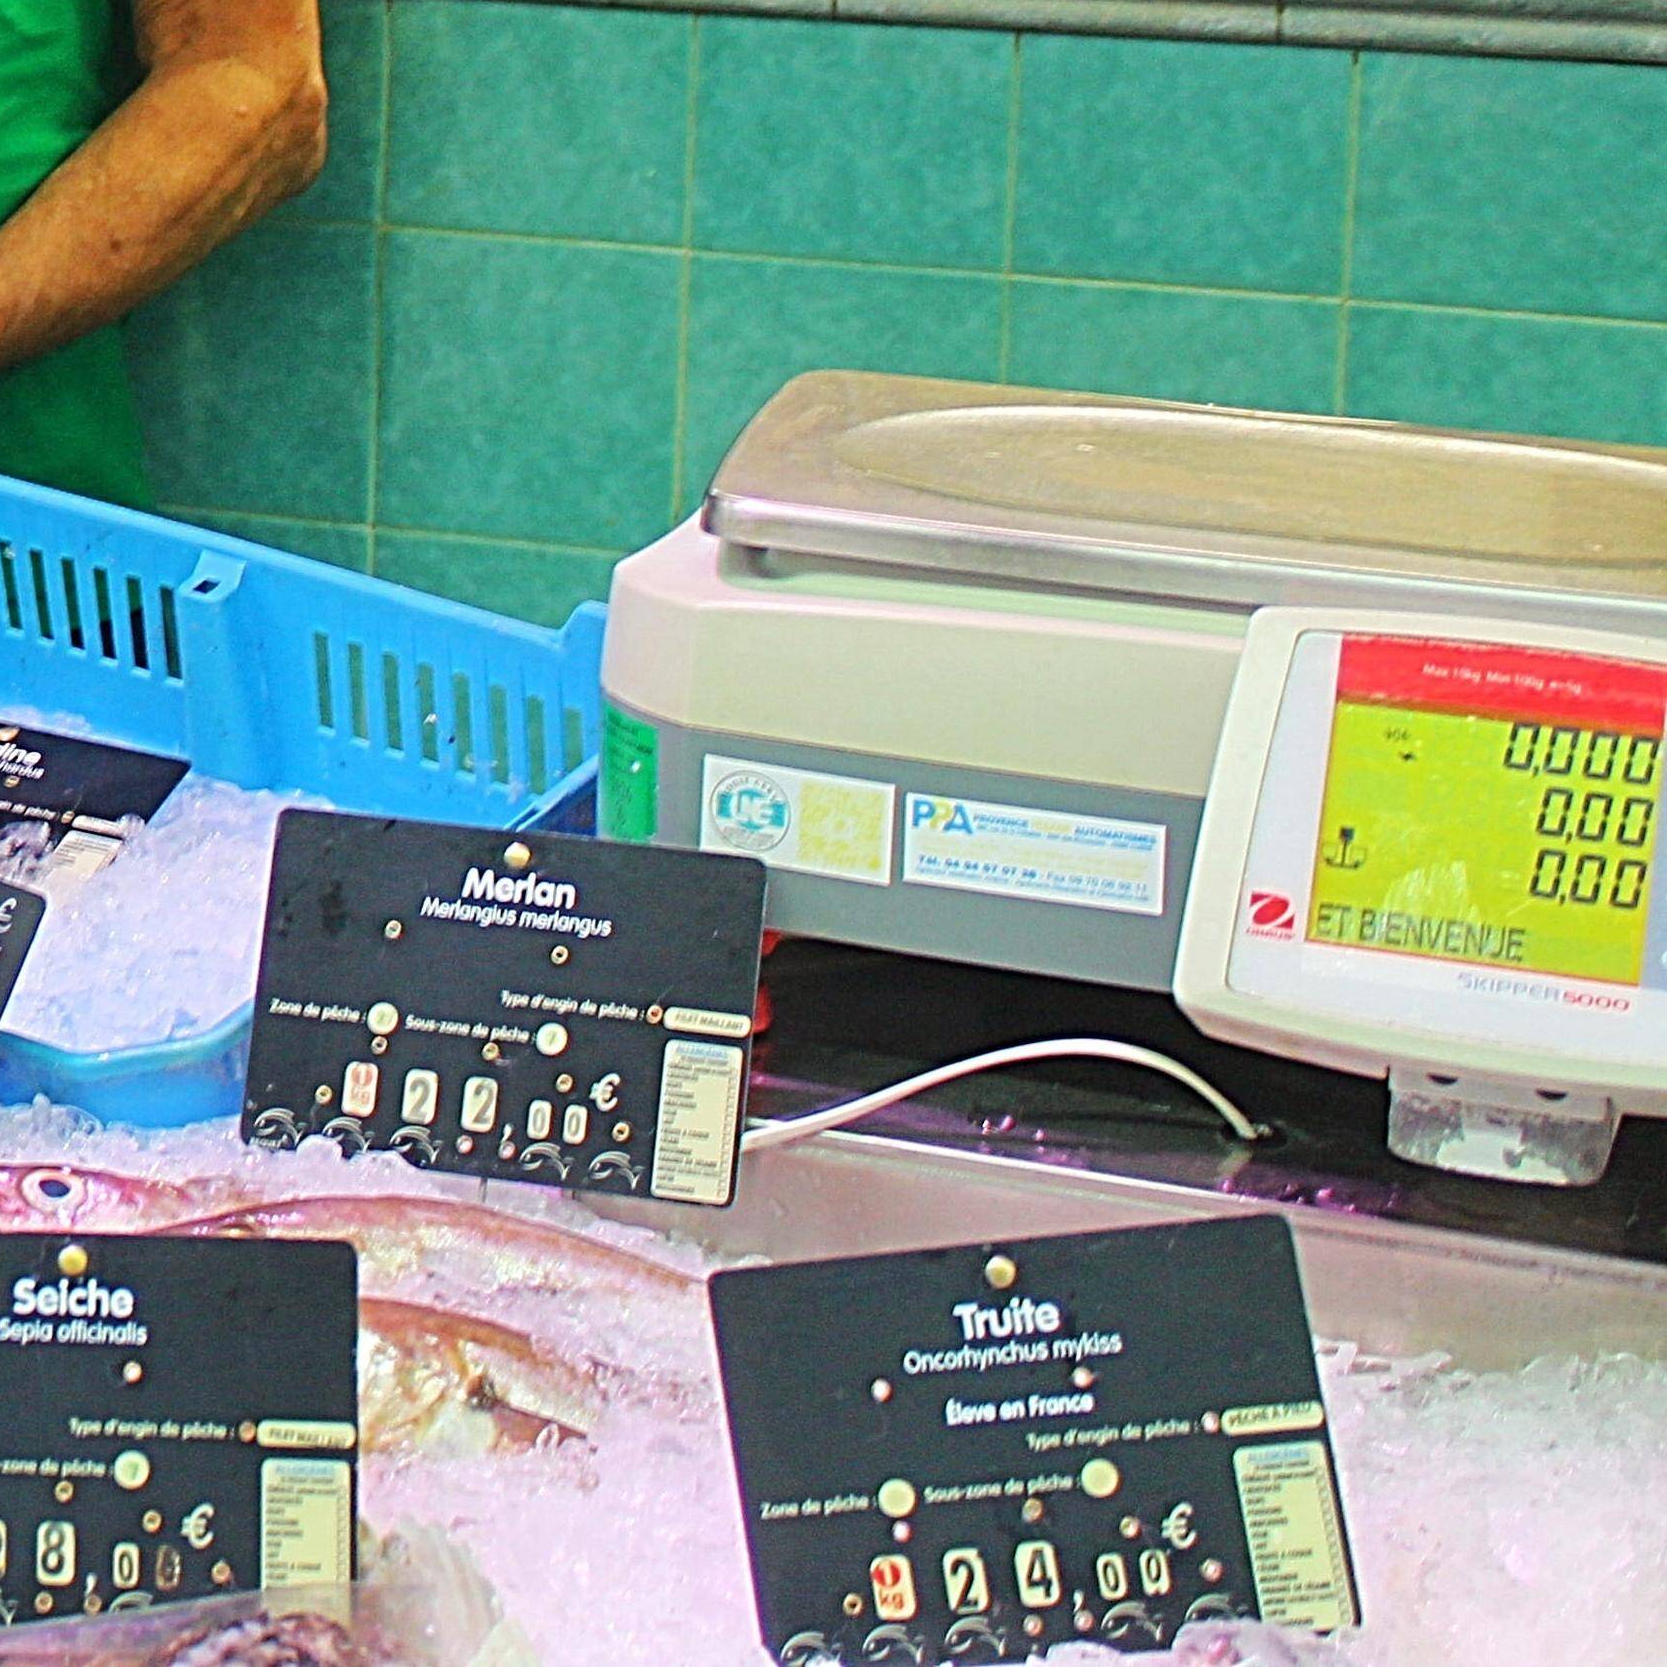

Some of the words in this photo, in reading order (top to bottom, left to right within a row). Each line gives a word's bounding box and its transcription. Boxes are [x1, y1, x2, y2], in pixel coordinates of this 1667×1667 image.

[1504, 722, 1660, 785] 0,000
[1536, 787, 1654, 847] 0,00
[461, 867, 577, 910] Merlan
[1529, 849, 1647, 909] 0,00
[420, 896, 516, 928] Merlangius
[519, 909, 612, 939] merlangus
[1358, 907, 1527, 964] BIENVENUE
[269, 997, 301, 1016] Zone
[302, 1000, 319, 1017] de
[501, 988, 531, 1010] Type
[581, 995, 598, 1013] de
[404, 1012, 470, 1034] Sous-zone
[471, 1019, 489, 1036] de
[12, 1277, 134, 1318] Seiche
[56, 1320, 147, 1347] officinalis
[954, 1297, 1060, 1341] Truite
[903, 1339, 1049, 1376] Oncorhynchus
[1052, 1332, 1123, 1360] mykiss
[1001, 1398, 1027, 1420] en
[1028, 1390, 1095, 1419] France
[69, 1417, 102, 1438] Type
[159, 1420, 179, 1437] de
[1026, 1431, 1062, 1453] Type
[1123, 1422, 1144, 1441] de
[760, 1498, 798, 1520] Zone
[800, 1496, 821, 1517] de
[923, 1481, 1004, 1504] Sous-zone
[1003, 1477, 1023, 1497] de
